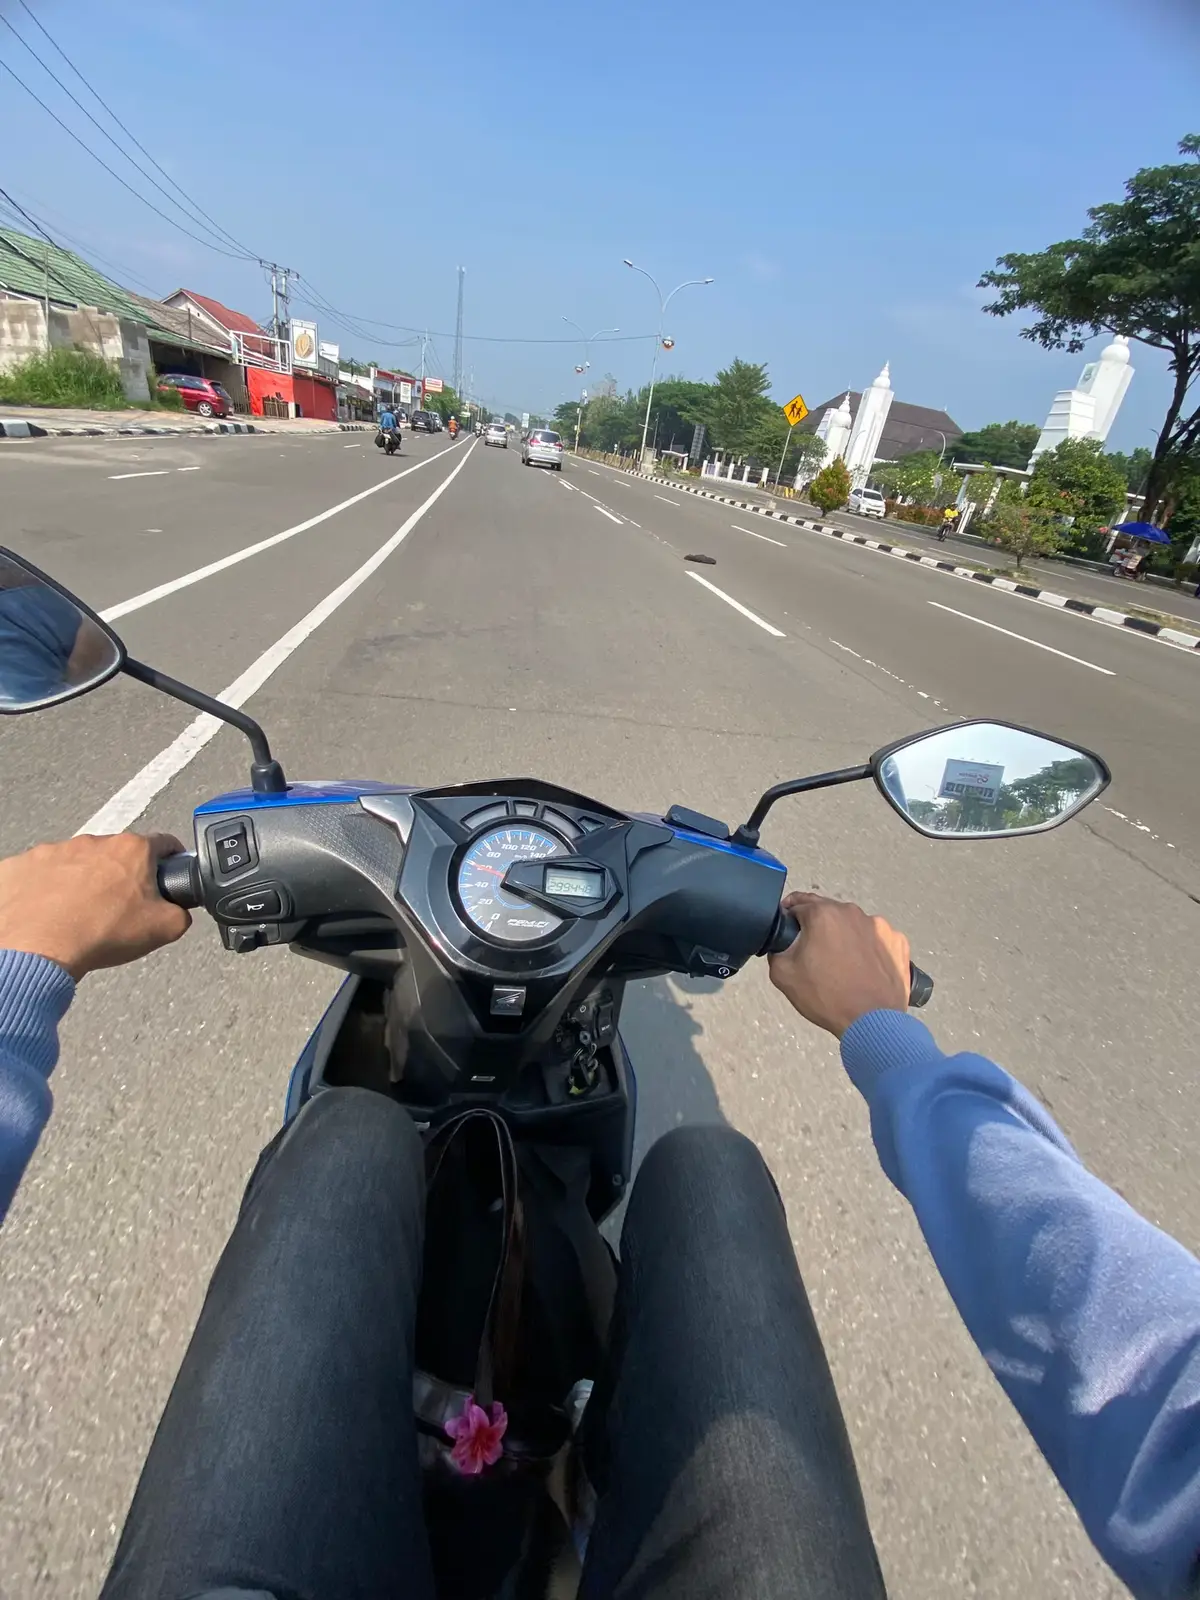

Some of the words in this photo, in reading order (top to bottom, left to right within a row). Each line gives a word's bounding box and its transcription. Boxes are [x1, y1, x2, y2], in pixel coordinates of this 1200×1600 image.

[501, 843, 518, 851] 100
[520, 843, 537, 851] 120
[491, 912, 501, 920] 0
